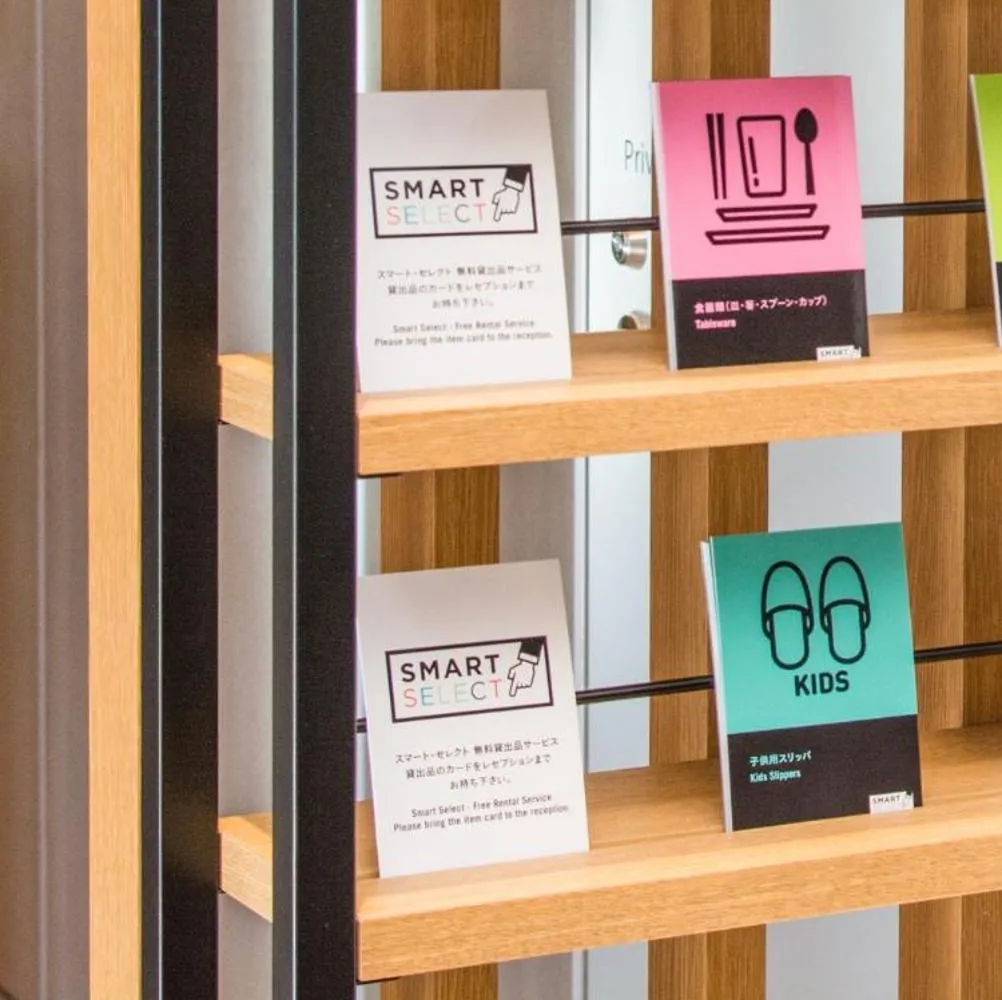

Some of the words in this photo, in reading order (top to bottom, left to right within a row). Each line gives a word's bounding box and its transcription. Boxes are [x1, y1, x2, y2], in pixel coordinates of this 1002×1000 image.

[384, 179, 484, 200] SMART
[386, 203, 487, 226] SELECT
[393, 324, 417, 333] Smart
[420, 323, 446, 333] Select
[455, 321, 472, 330] Free
[475, 320, 501, 330] Rental
[504, 319, 535, 329] Service
[694, 319, 736, 330] Tableware
[374, 337, 403, 347] Please
[405, 337, 427, 347] bring
[430, 336, 442, 344] the
[400, 654, 500, 683] SMART
[403, 679, 502, 708] SELECT
[794, 670, 850, 696] KIDS
[749, 750, 812, 767] 子供用スリッパ
[750, 773, 767, 783] Kids
[769, 769, 801, 781] Slippers
[411, 807, 436, 818] Smart
[439, 804, 465, 815] Select
[473, 800, 491, 810] Free
[493, 797, 519, 808] Rental
[521, 794, 552, 804] Service
[872, 795, 901, 804] SMART
[394, 821, 421, 832] Please
[424, 818, 445, 829] bring
[448, 816, 461, 825] the
[464, 814, 481, 824] item
[484, 811, 503, 822] card
[504, 811, 513, 820] to
[515, 808, 527, 817] the
